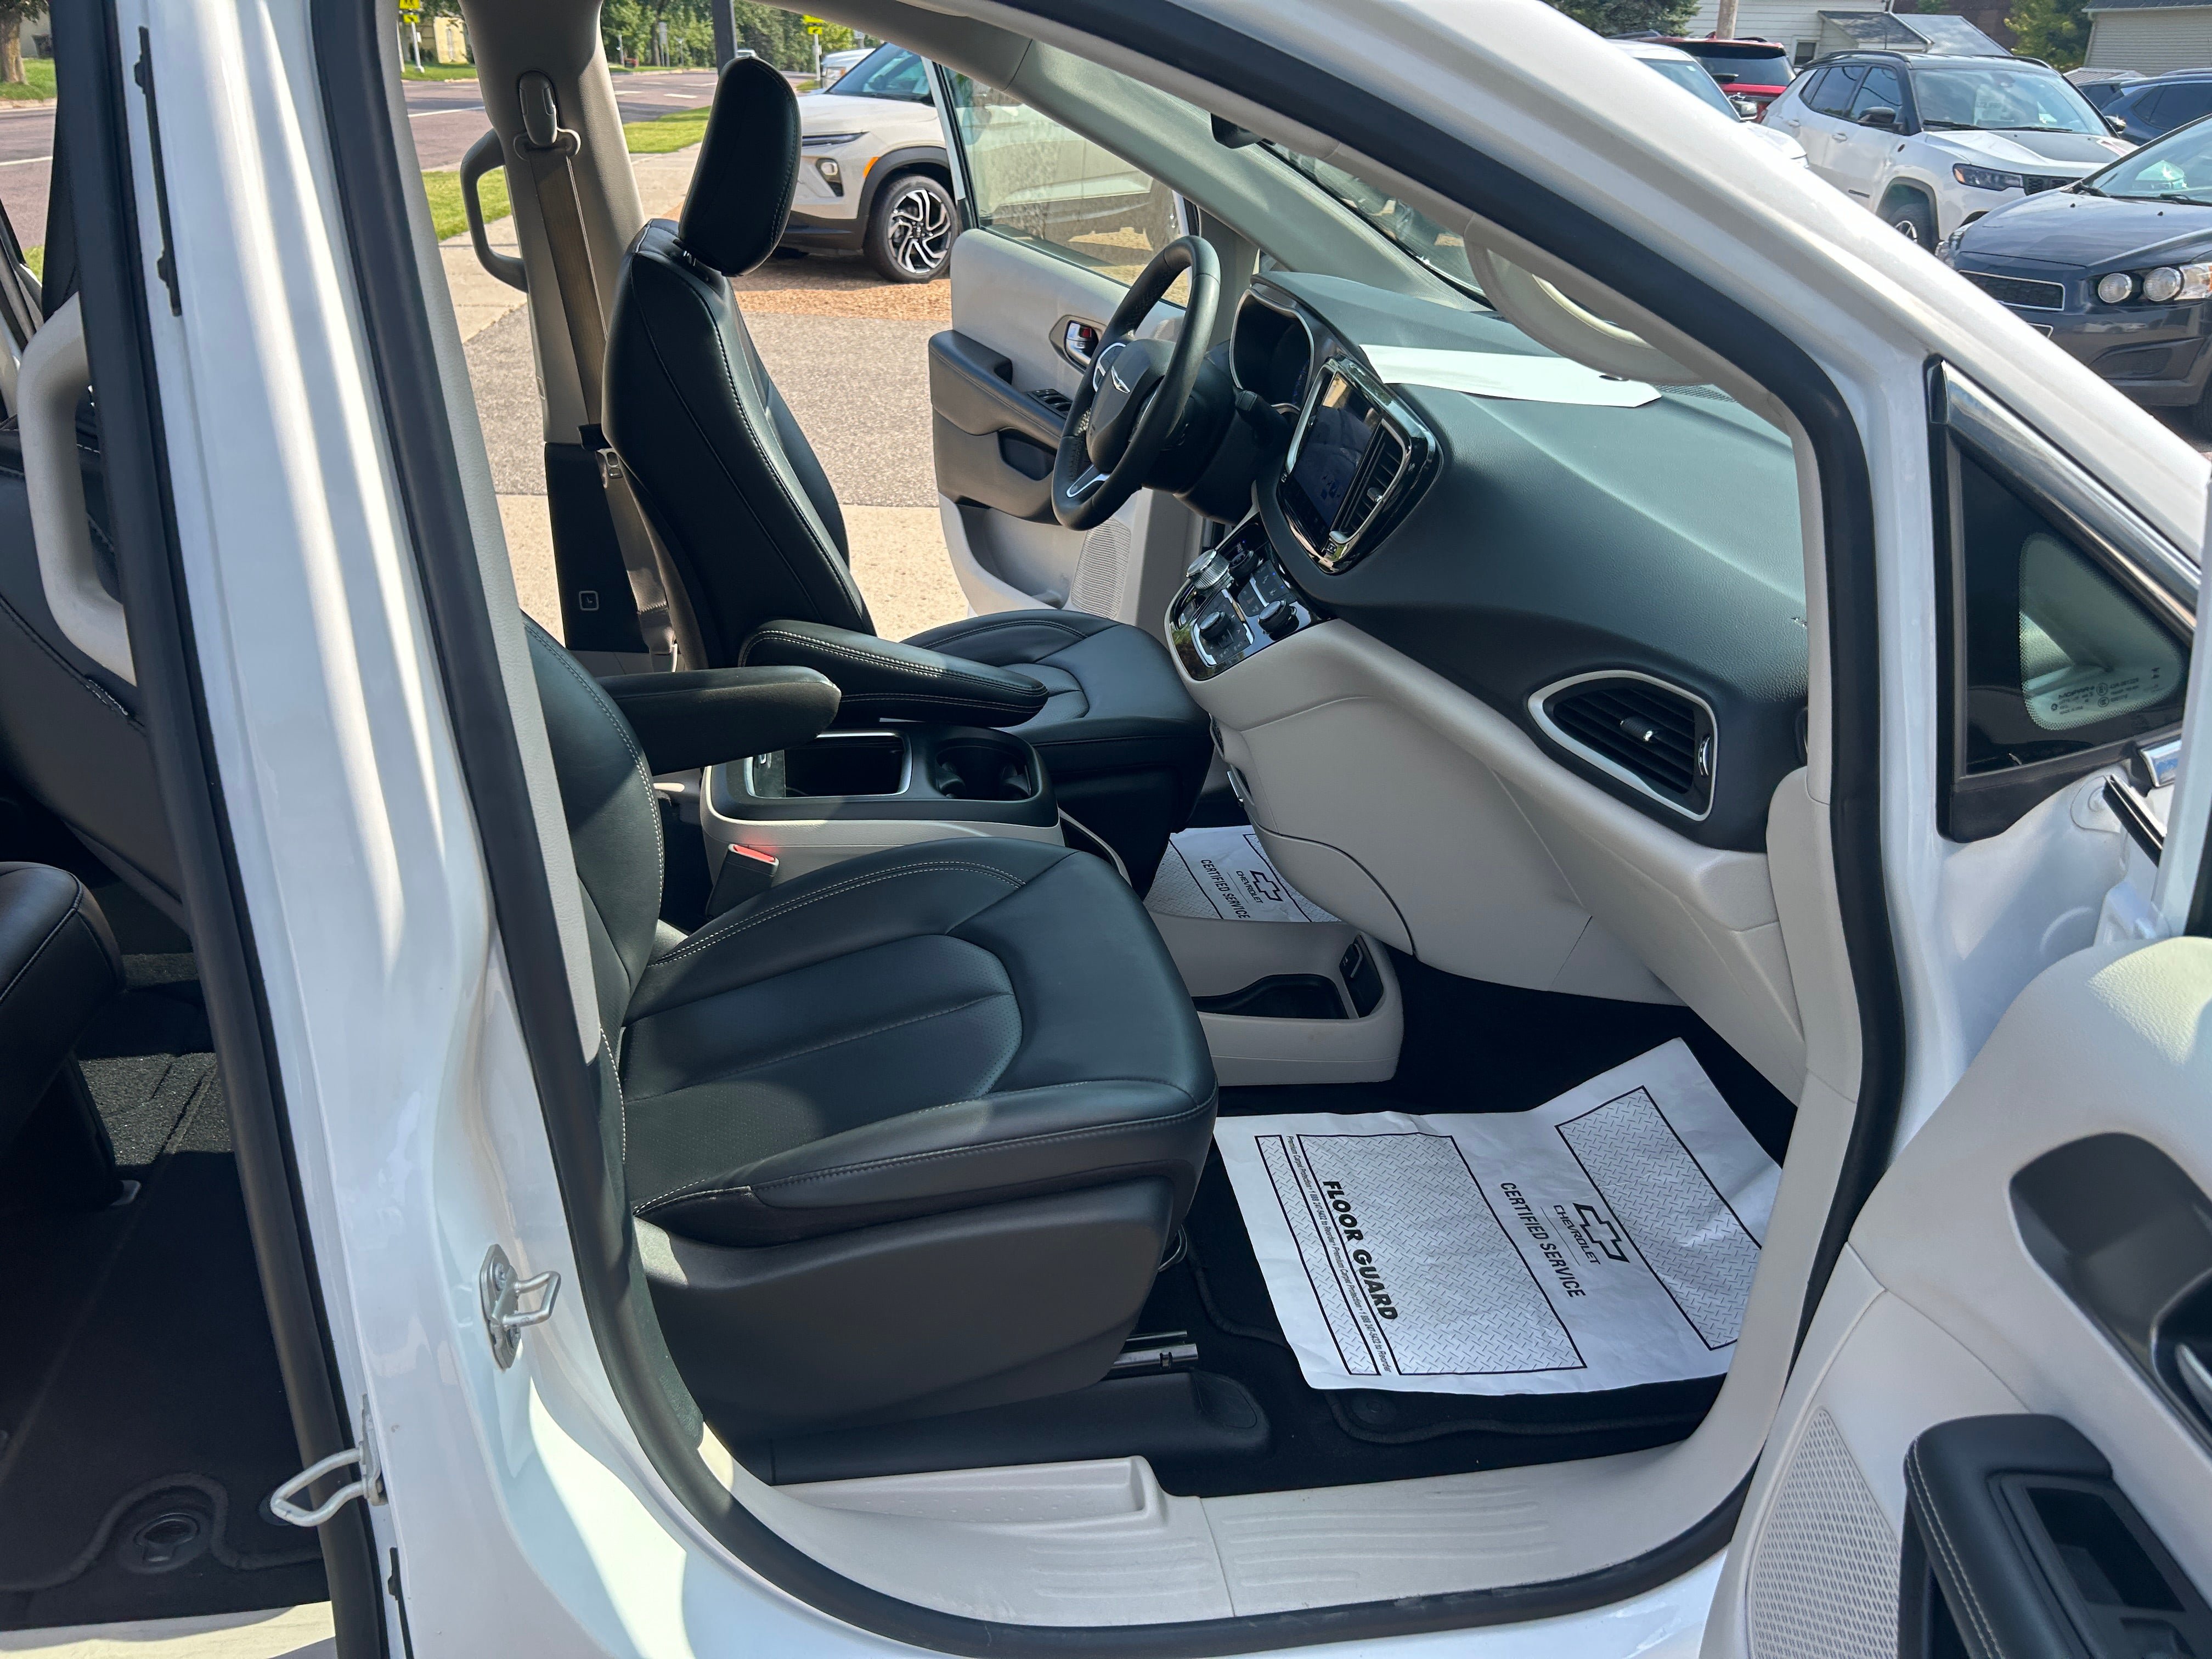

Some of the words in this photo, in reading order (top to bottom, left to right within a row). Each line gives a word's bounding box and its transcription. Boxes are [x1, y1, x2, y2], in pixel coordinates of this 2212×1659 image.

[1201, 859, 1230, 891] CERTIFIED
[1222, 893, 1251, 919] SERVICE
[1235, 871, 1263, 903] CHEVROLET
[1323, 1181, 1364, 1242] FLOOR
[1353, 1249, 1398, 1319] GUARD
[1500, 1182, 1549, 1240] CERTIFIED
[1539, 1243, 1587, 1297] SERVICE
[1553, 1205, 1600, 1265] CHEVROLET
[1377, 1351, 1392, 1373] Reorder
